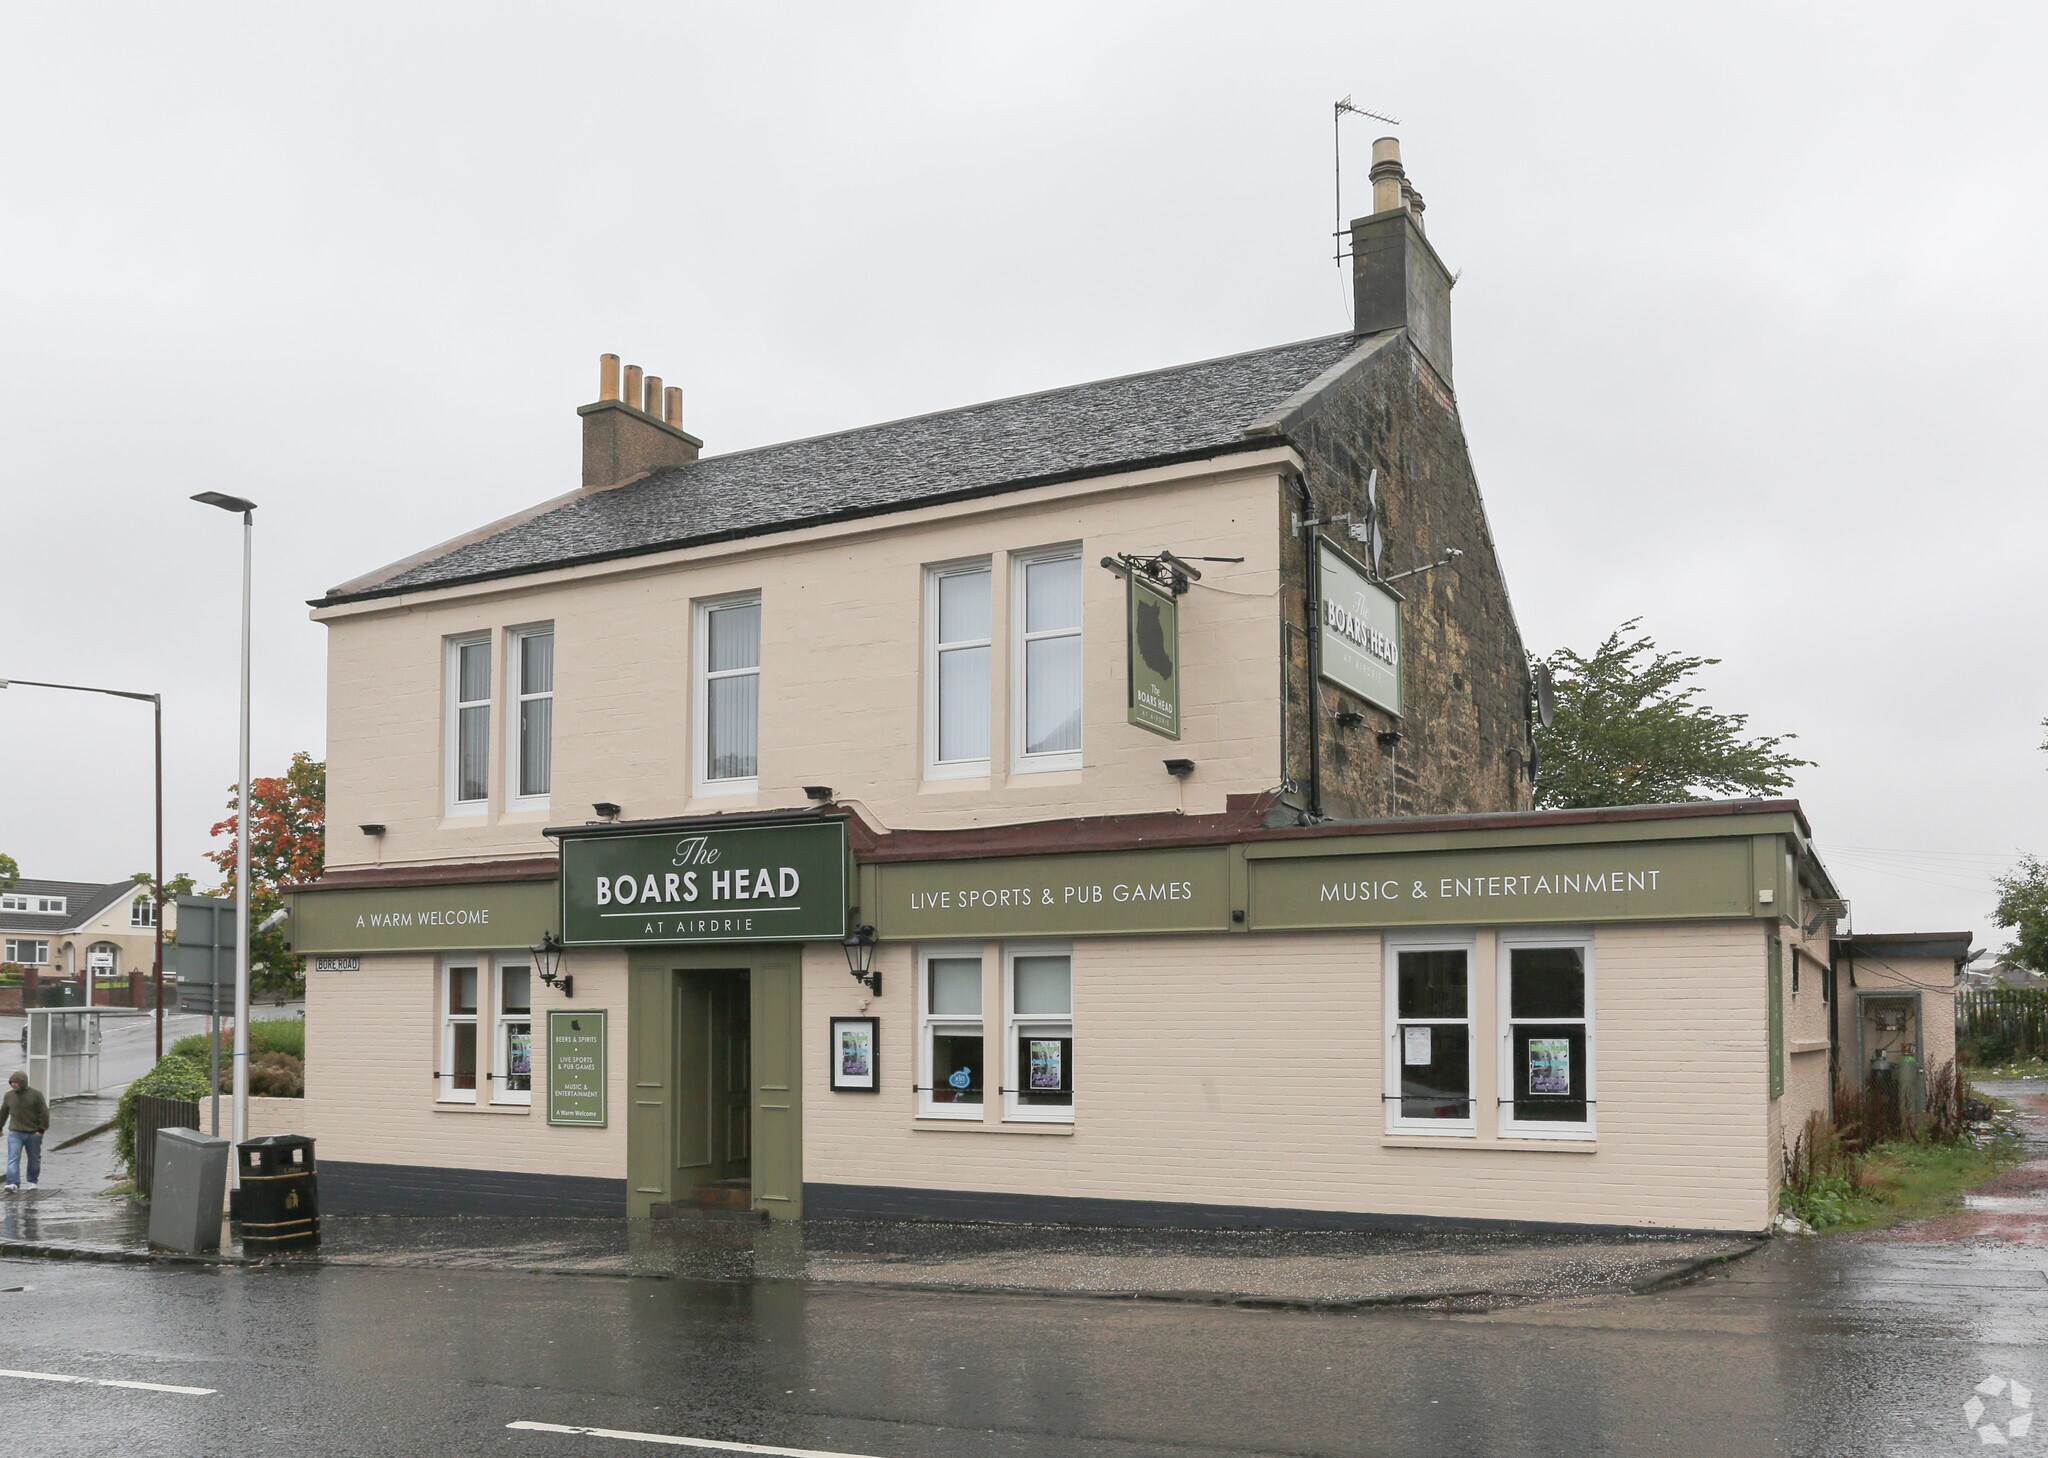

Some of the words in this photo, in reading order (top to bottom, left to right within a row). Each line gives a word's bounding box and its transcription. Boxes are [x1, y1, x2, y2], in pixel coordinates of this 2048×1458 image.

[1352, 591, 1370, 620] The
[1328, 598, 1367, 647] BOARS
[1370, 626, 1398, 666] HEAD
[1343, 653, 1352, 665] AT
[1355, 663, 1382, 683] AIRDRIE
[1137, 690, 1157, 707] BOARS
[1158, 699, 1173, 713] HEAD
[1151, 684, 1160, 696] The
[672, 836, 721, 867] The
[597, 871, 698, 906] BOARS
[712, 867, 800, 900] HEAD
[911, 891, 950, 910] LIVE
[958, 888, 1032, 908] SPORTS
[1040, 888, 1055, 906] &
[1064, 885, 1103, 904] PUB
[1112, 881, 1192, 903] GAMES
[1320, 880, 1399, 902] MUSIC
[1411, 880, 1428, 899] &
[1440, 870, 1661, 899] ENTERTAINMENT
[356, 914, 365, 928] A
[370, 912, 412, 927] WARM
[417, 909, 489, 926] WELCOME
[644, 921, 665, 933] AT
[676, 919, 753, 933] AIRDRIE
[318, 959, 336, 969] BORE
[338, 958, 357, 969] ROAD
